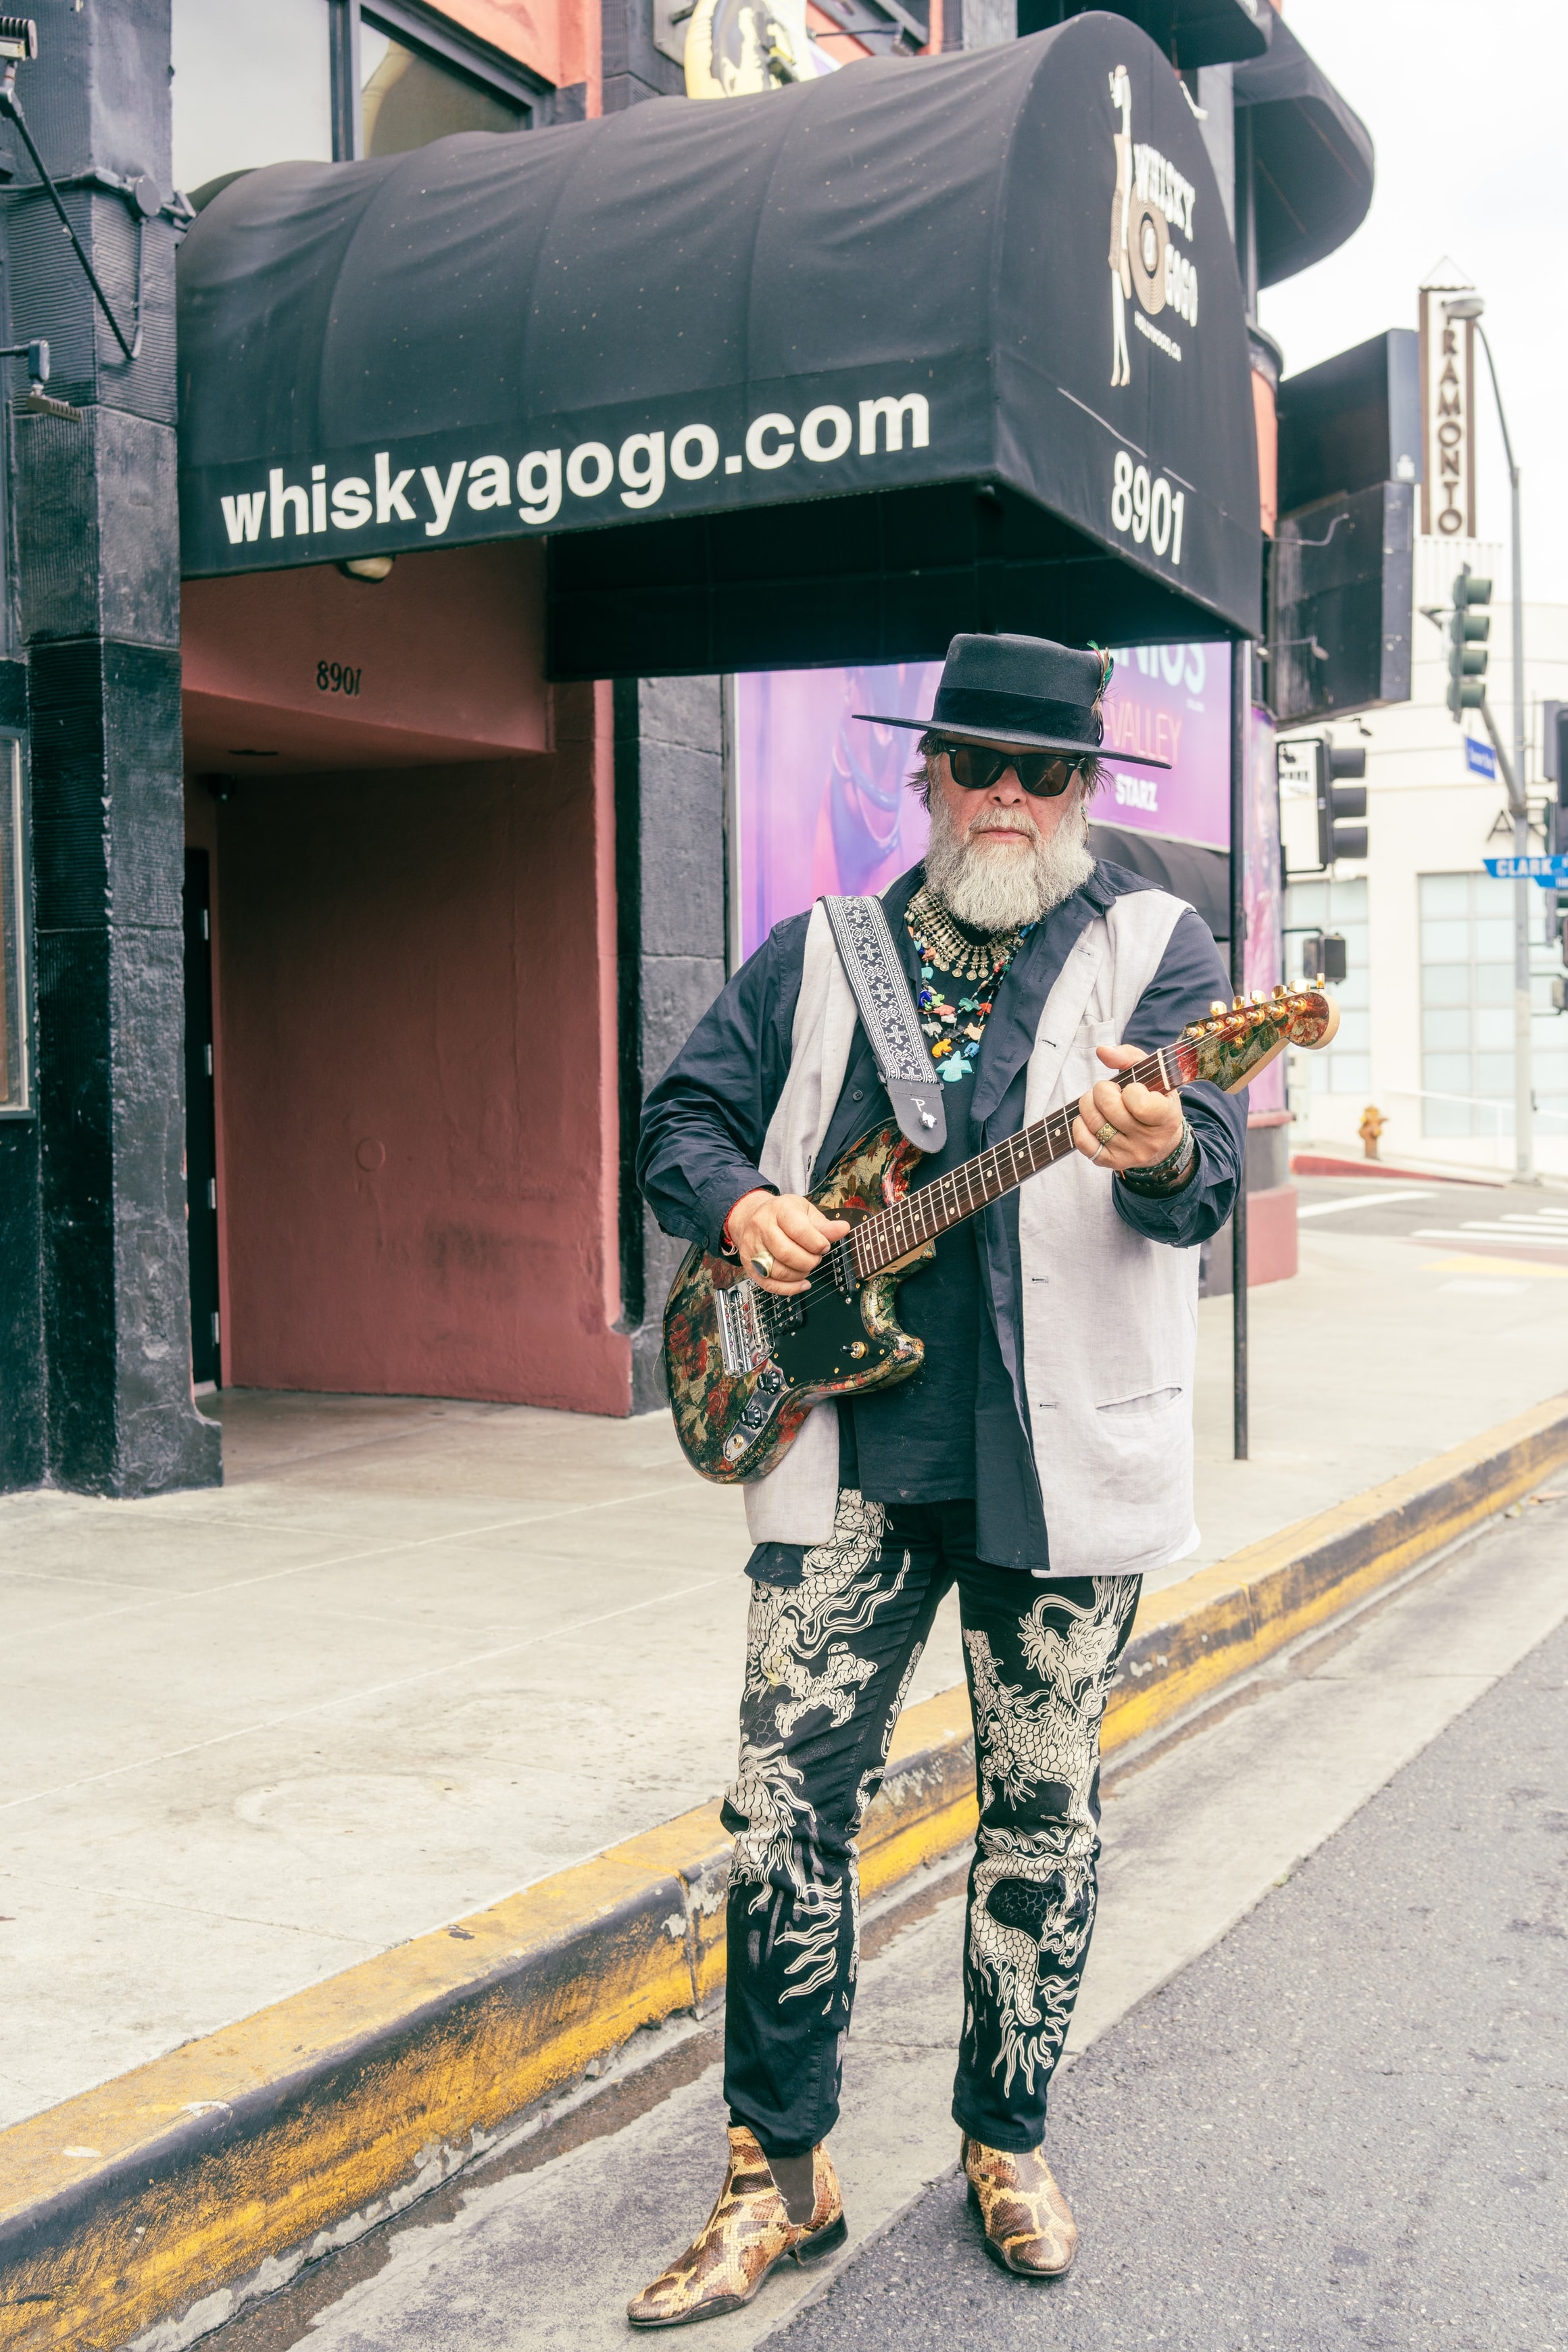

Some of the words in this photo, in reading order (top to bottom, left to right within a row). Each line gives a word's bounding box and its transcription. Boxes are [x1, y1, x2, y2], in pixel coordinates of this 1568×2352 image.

[1133, 143, 1195, 242] WHISKY
[221, 392, 929, 544] whiskyagogo.com
[1112, 451, 1184, 564] 8901
[316, 660, 362, 696] 8901
[1115, 773, 1158, 812] STARZ
[1496, 858, 1552, 877] CLARK
